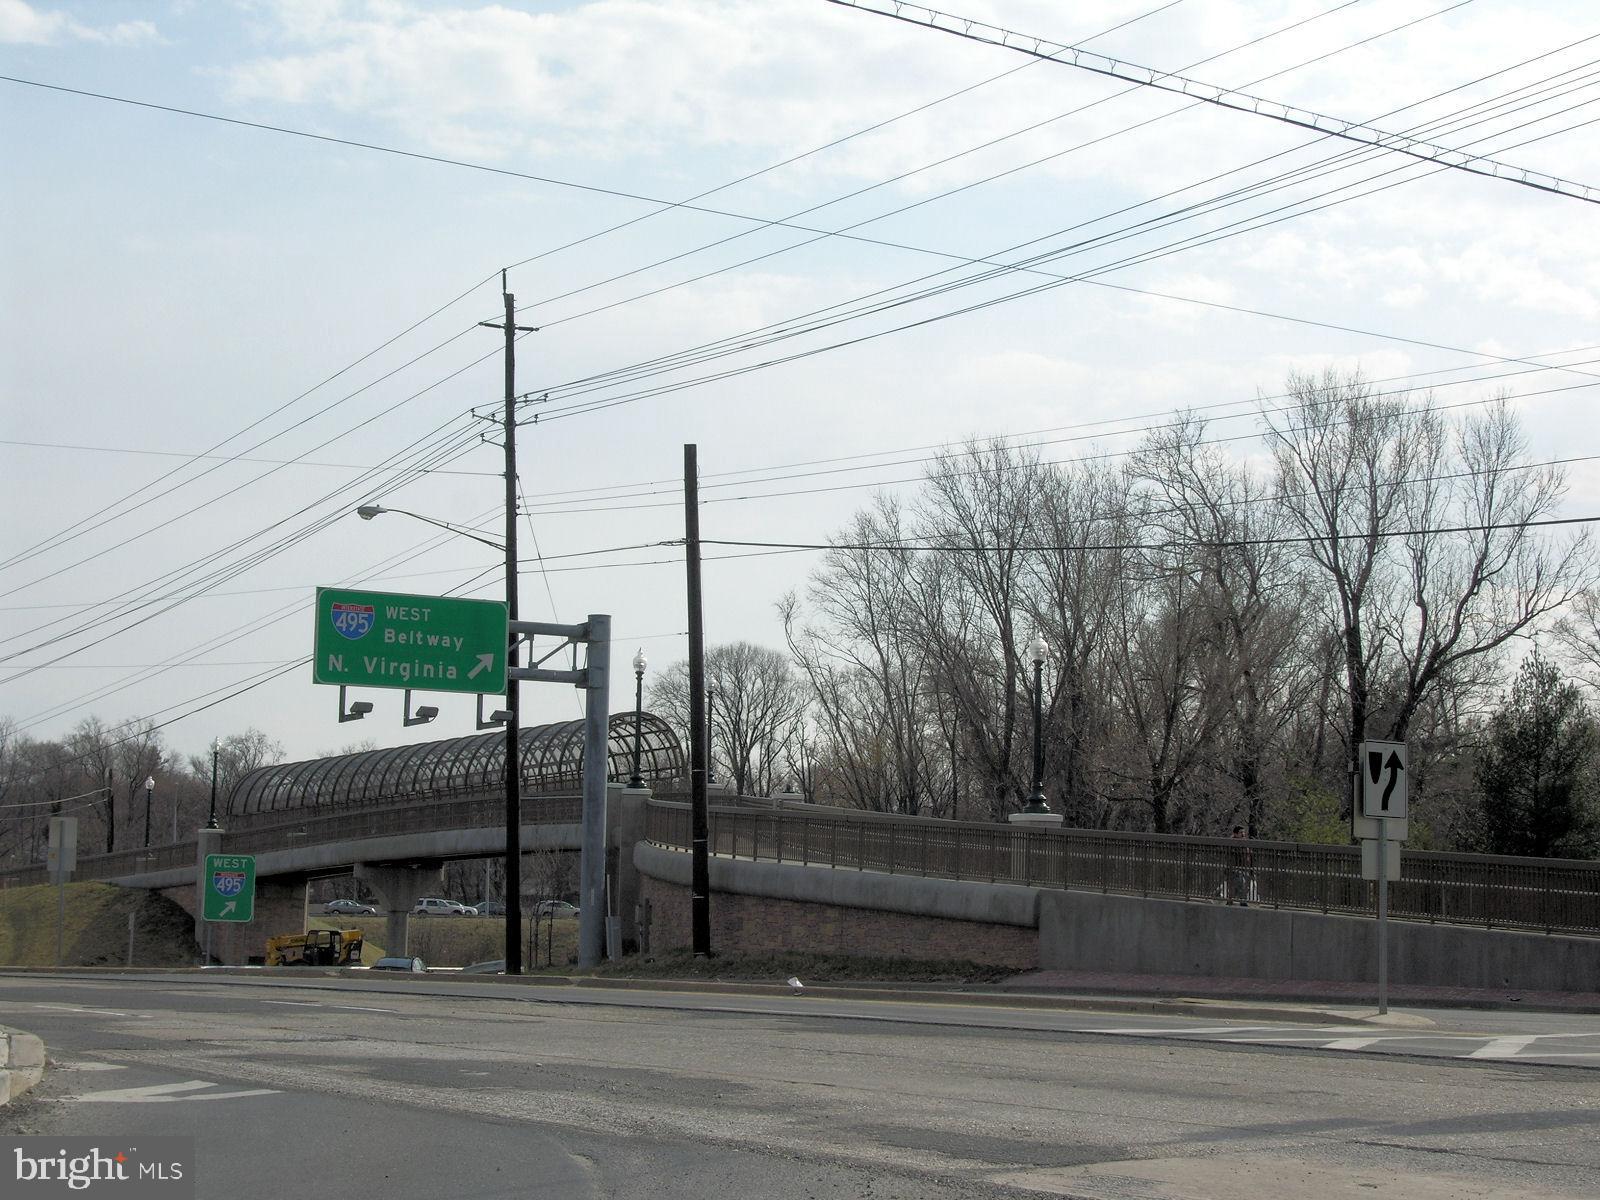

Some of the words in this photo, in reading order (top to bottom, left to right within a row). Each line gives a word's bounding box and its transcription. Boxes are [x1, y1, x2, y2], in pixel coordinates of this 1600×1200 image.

[336, 612, 369, 633] 495
[386, 606, 431, 622] WEST
[384, 628, 464, 651] Beltway
[328, 654, 348, 672] N.
[363, 656, 457, 682] Virginia
[213, 858, 248, 868] WEST
[216, 877, 241, 892] 495
